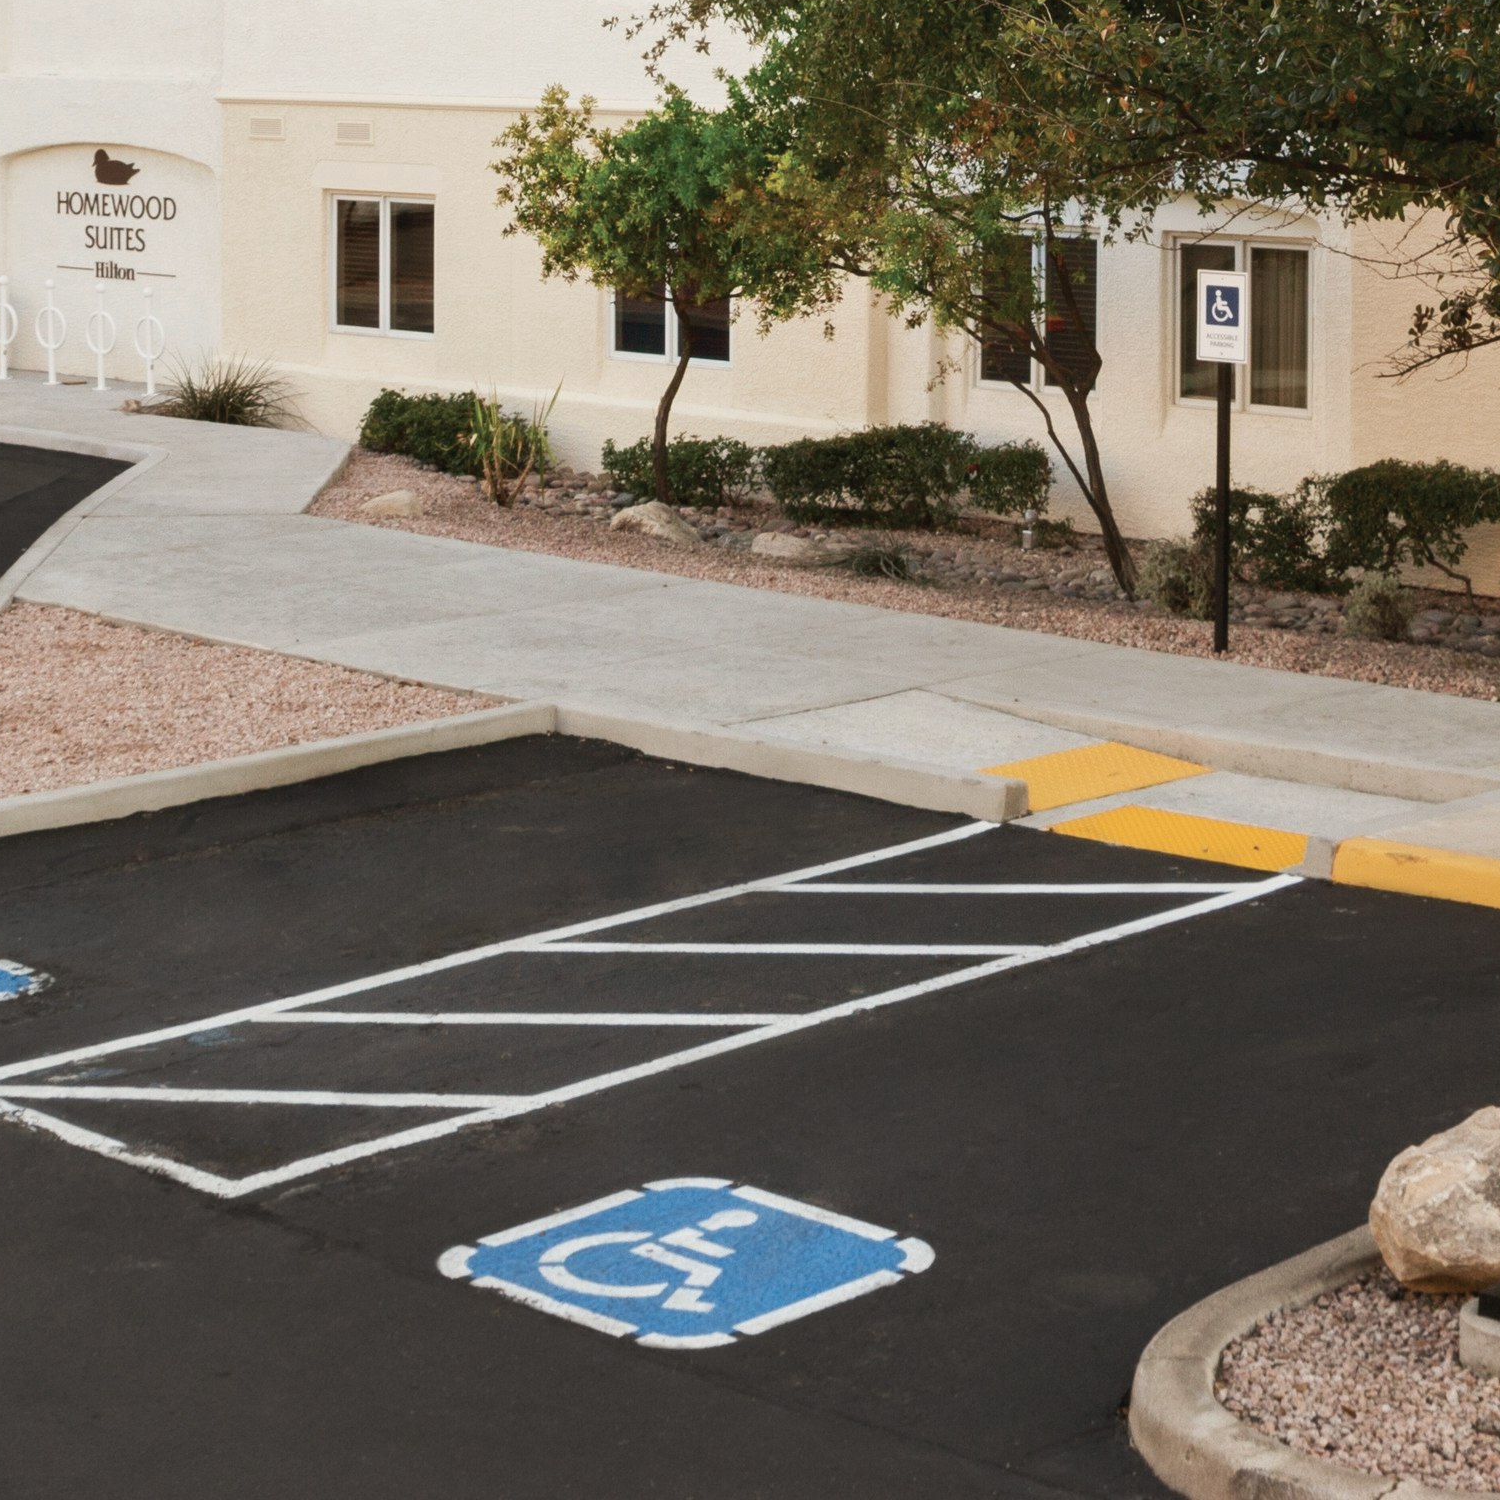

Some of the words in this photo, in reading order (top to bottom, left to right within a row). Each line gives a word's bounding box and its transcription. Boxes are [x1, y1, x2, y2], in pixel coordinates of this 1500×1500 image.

[56, 191, 177, 221] HOMEWOOD
[85, 225, 146, 252] SUITES
[95, 261, 136, 281] Hilton
